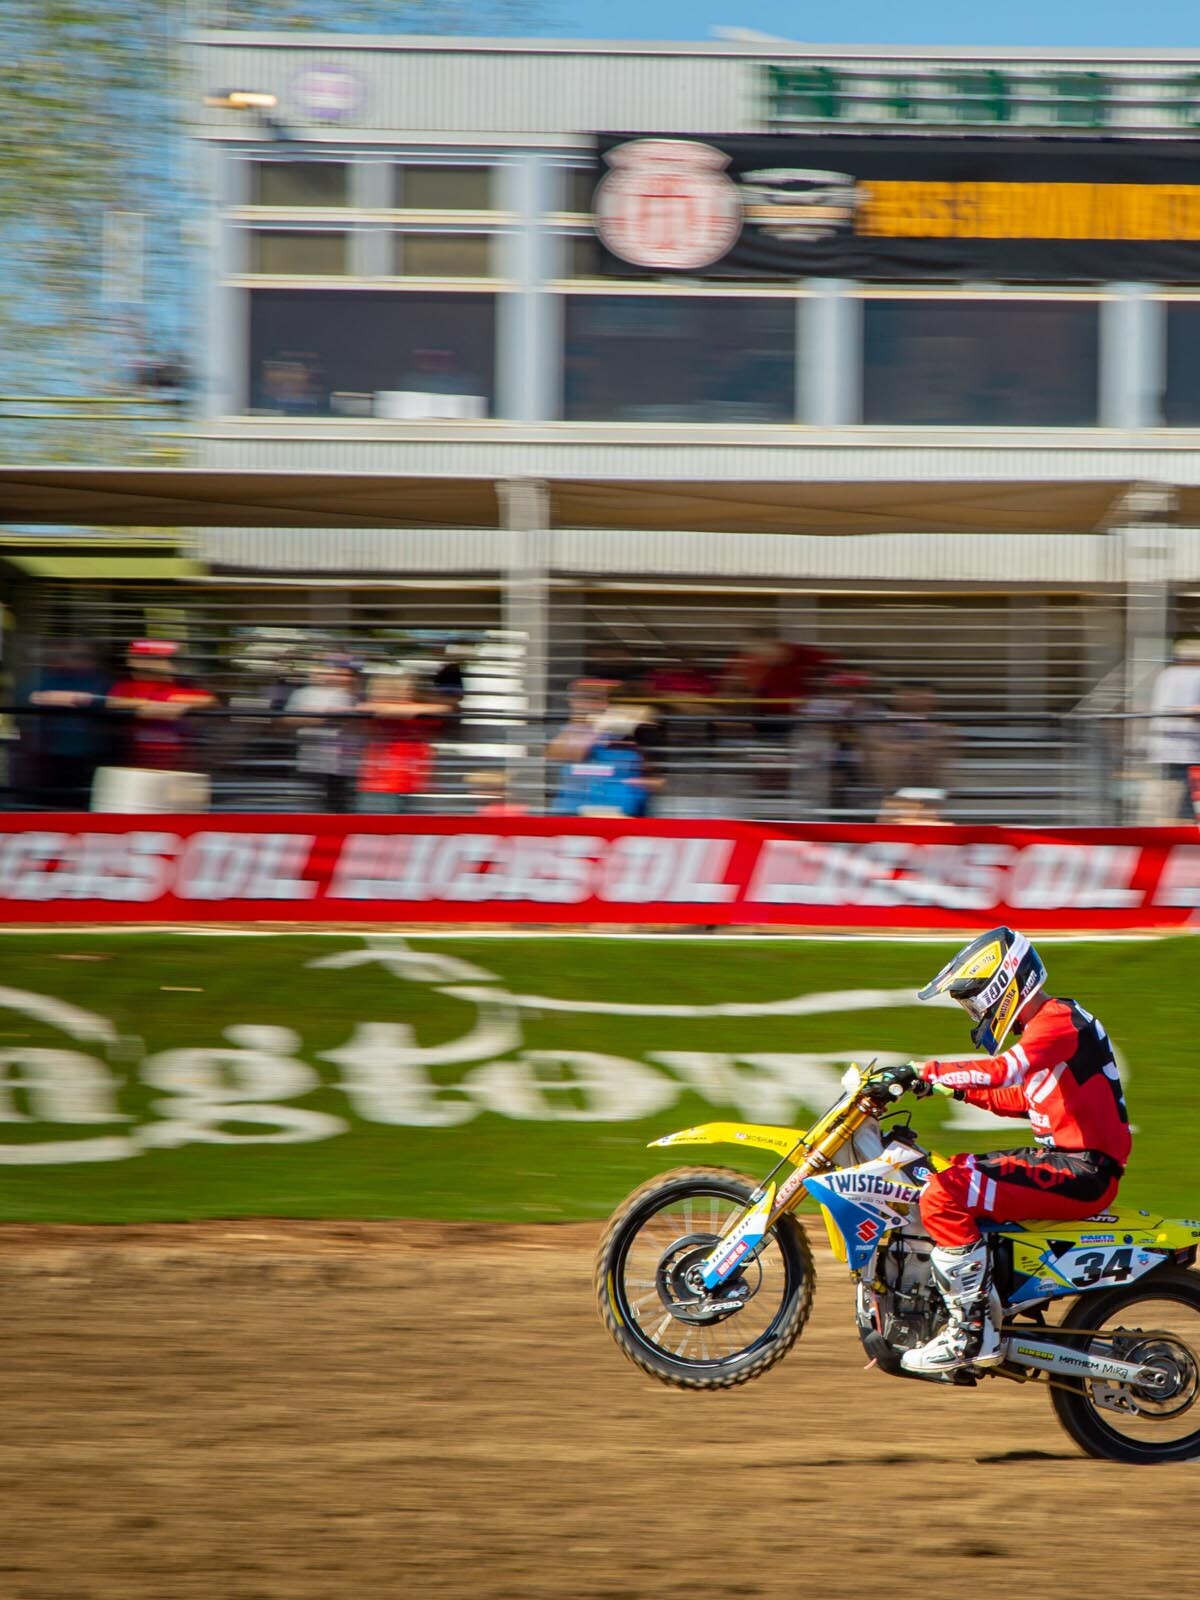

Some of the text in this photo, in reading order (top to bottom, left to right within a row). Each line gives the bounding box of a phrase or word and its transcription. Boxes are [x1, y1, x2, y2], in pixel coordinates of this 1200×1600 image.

[1020, 970, 1038, 998] THOR
[824, 1174, 894, 1196] TWISTED
[1071, 1248, 1134, 1288] 34
